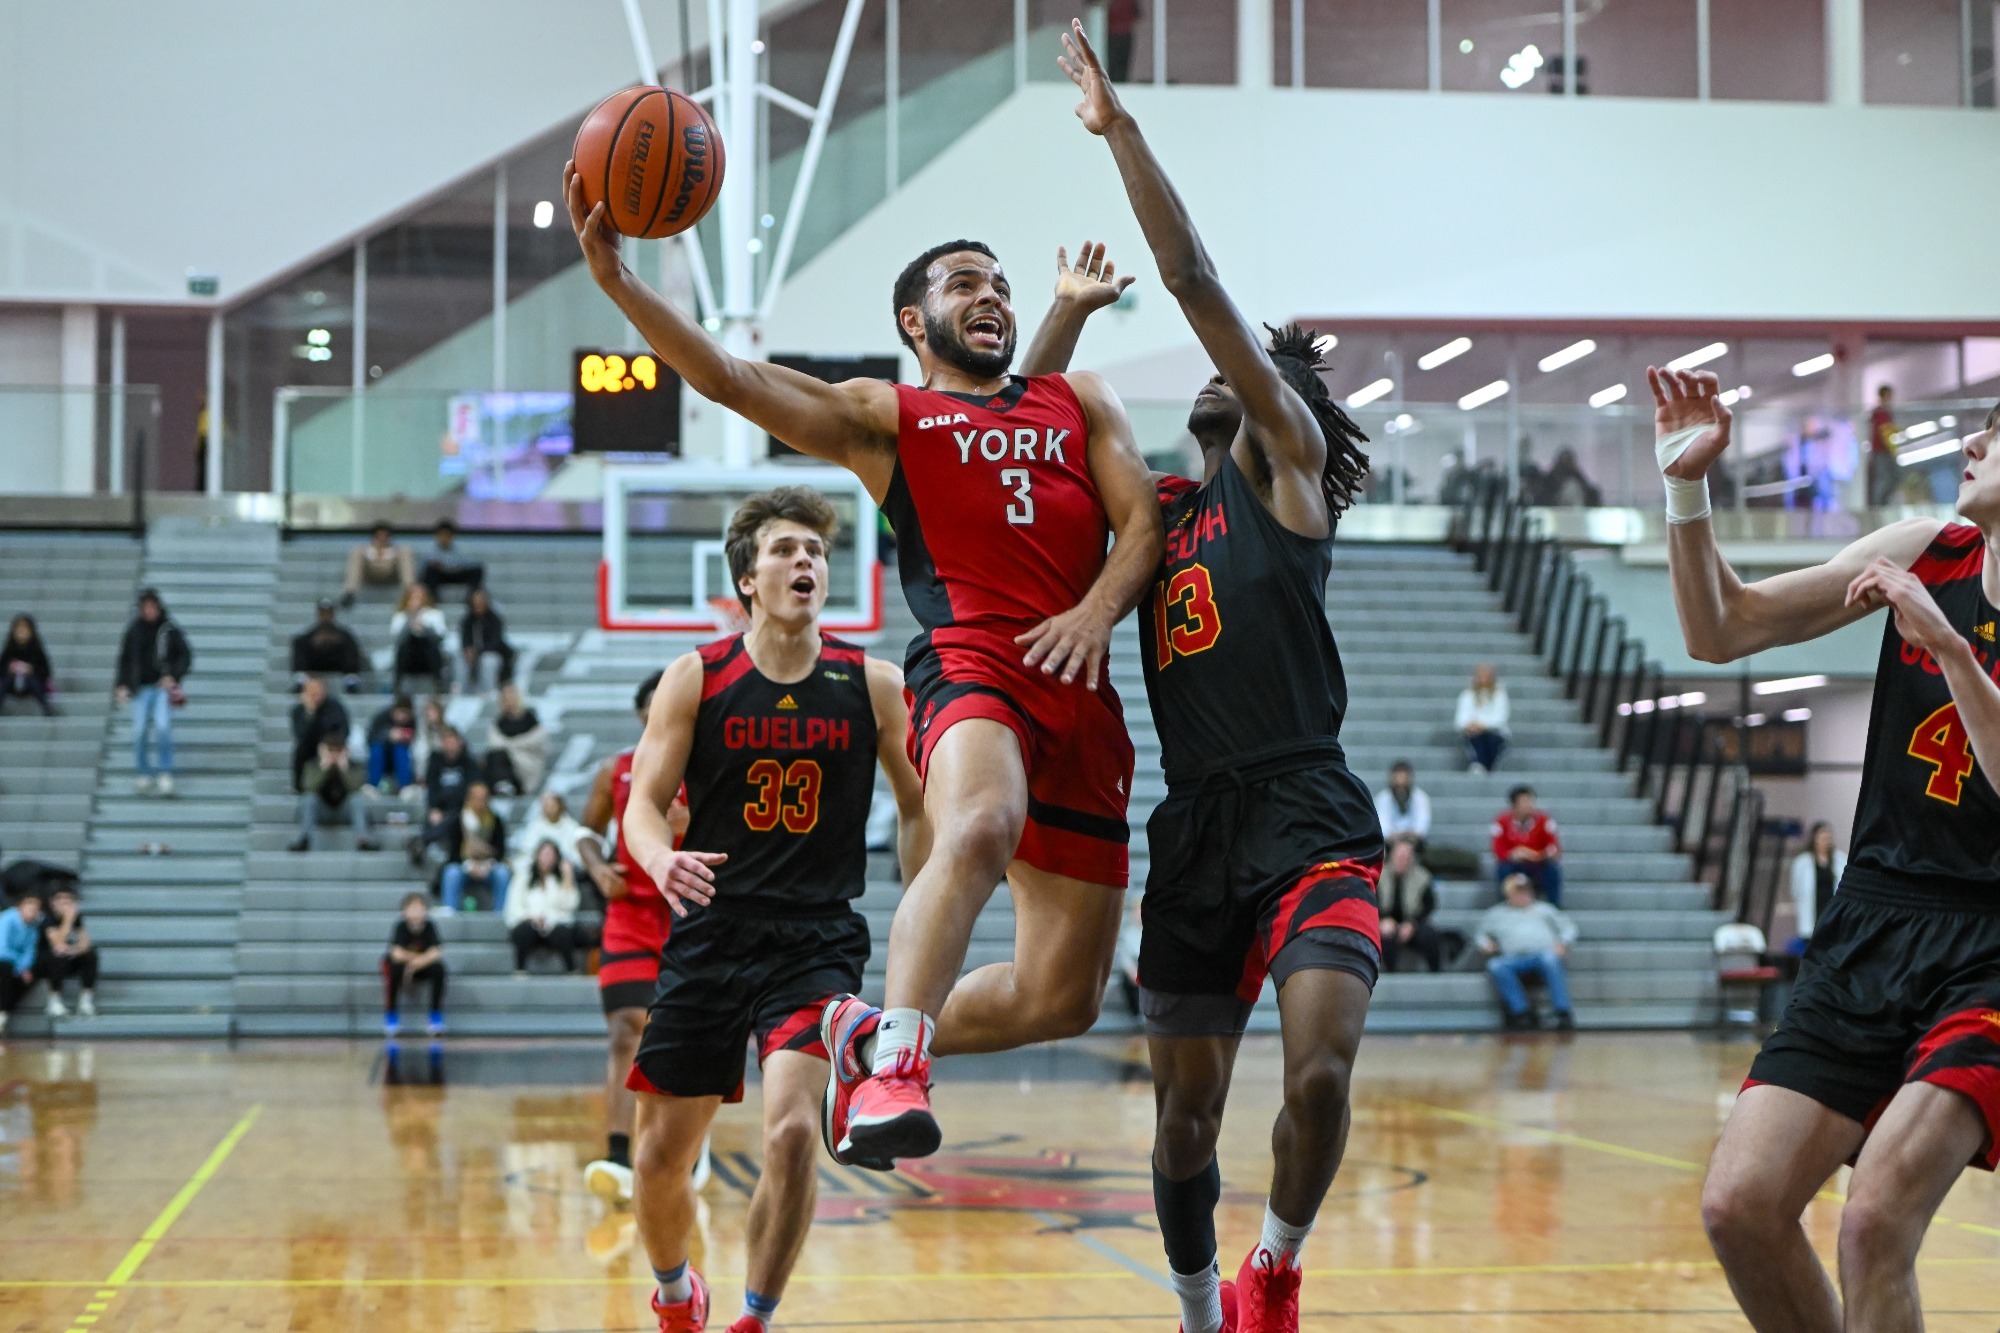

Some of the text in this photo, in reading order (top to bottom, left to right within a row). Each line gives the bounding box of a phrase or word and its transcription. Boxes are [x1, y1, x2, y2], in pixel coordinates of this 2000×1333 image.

[627, 120, 655, 217] EVOLUTION
[664, 124, 707, 223] Wilson
[917, 412, 971, 430] OUA
[952, 427, 1072, 464] YORK
[1000, 468, 1035, 525] 3
[1165, 502, 1228, 567] ELPH
[1153, 562, 1222, 672] 13
[724, 717, 850, 750] GUELPH
[1907, 700, 1974, 806] 4
[743, 759, 823, 833] 33
